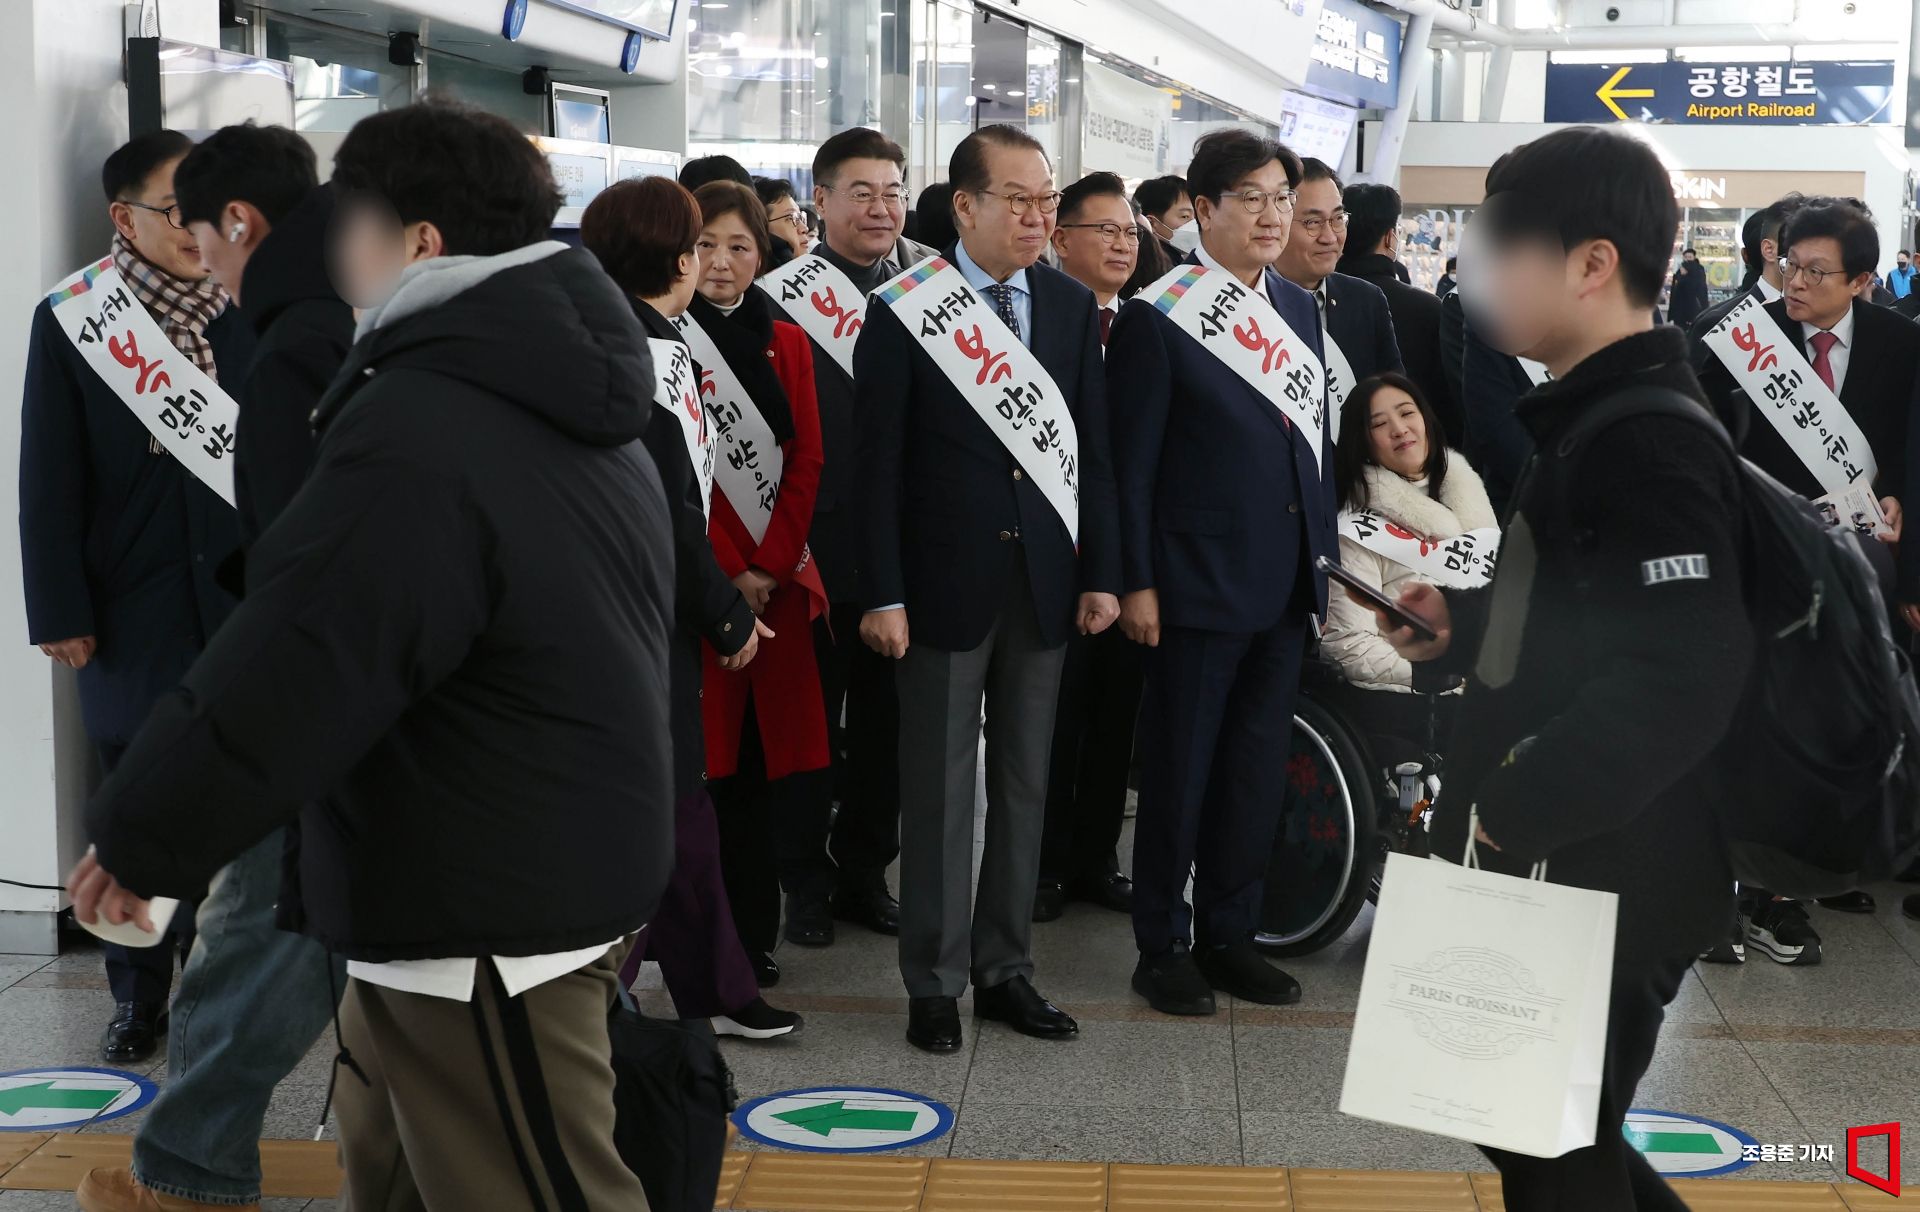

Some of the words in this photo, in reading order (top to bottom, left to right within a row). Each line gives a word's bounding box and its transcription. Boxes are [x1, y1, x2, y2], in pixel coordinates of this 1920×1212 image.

[1687, 65, 1818, 98] 공항철도
[1687, 102, 1743, 119] Airport
[1748, 102, 1815, 118] Railroad
[780, 258, 828, 303] 새해
[78, 286, 131, 346] 새해
[108, 329, 172, 395] 복
[158, 388, 209, 440] 많이
[920, 285, 977, 339] 새해
[953, 323, 1013, 386] 복
[995, 381, 1044, 431] 많이
[1200, 281, 1247, 340] 새해
[1232, 315, 1291, 374] 복
[1284, 363, 1315, 411] 많이
[1731, 322, 1778, 373] 복
[1763, 369, 1804, 409] 많이
[1792, 400, 1864, 484] 받으세요
[1444, 533, 1480, 575] 많이
[1407, 983, 1453, 1004] PARIS
[1454, 992, 1542, 1022] CROISSANT
